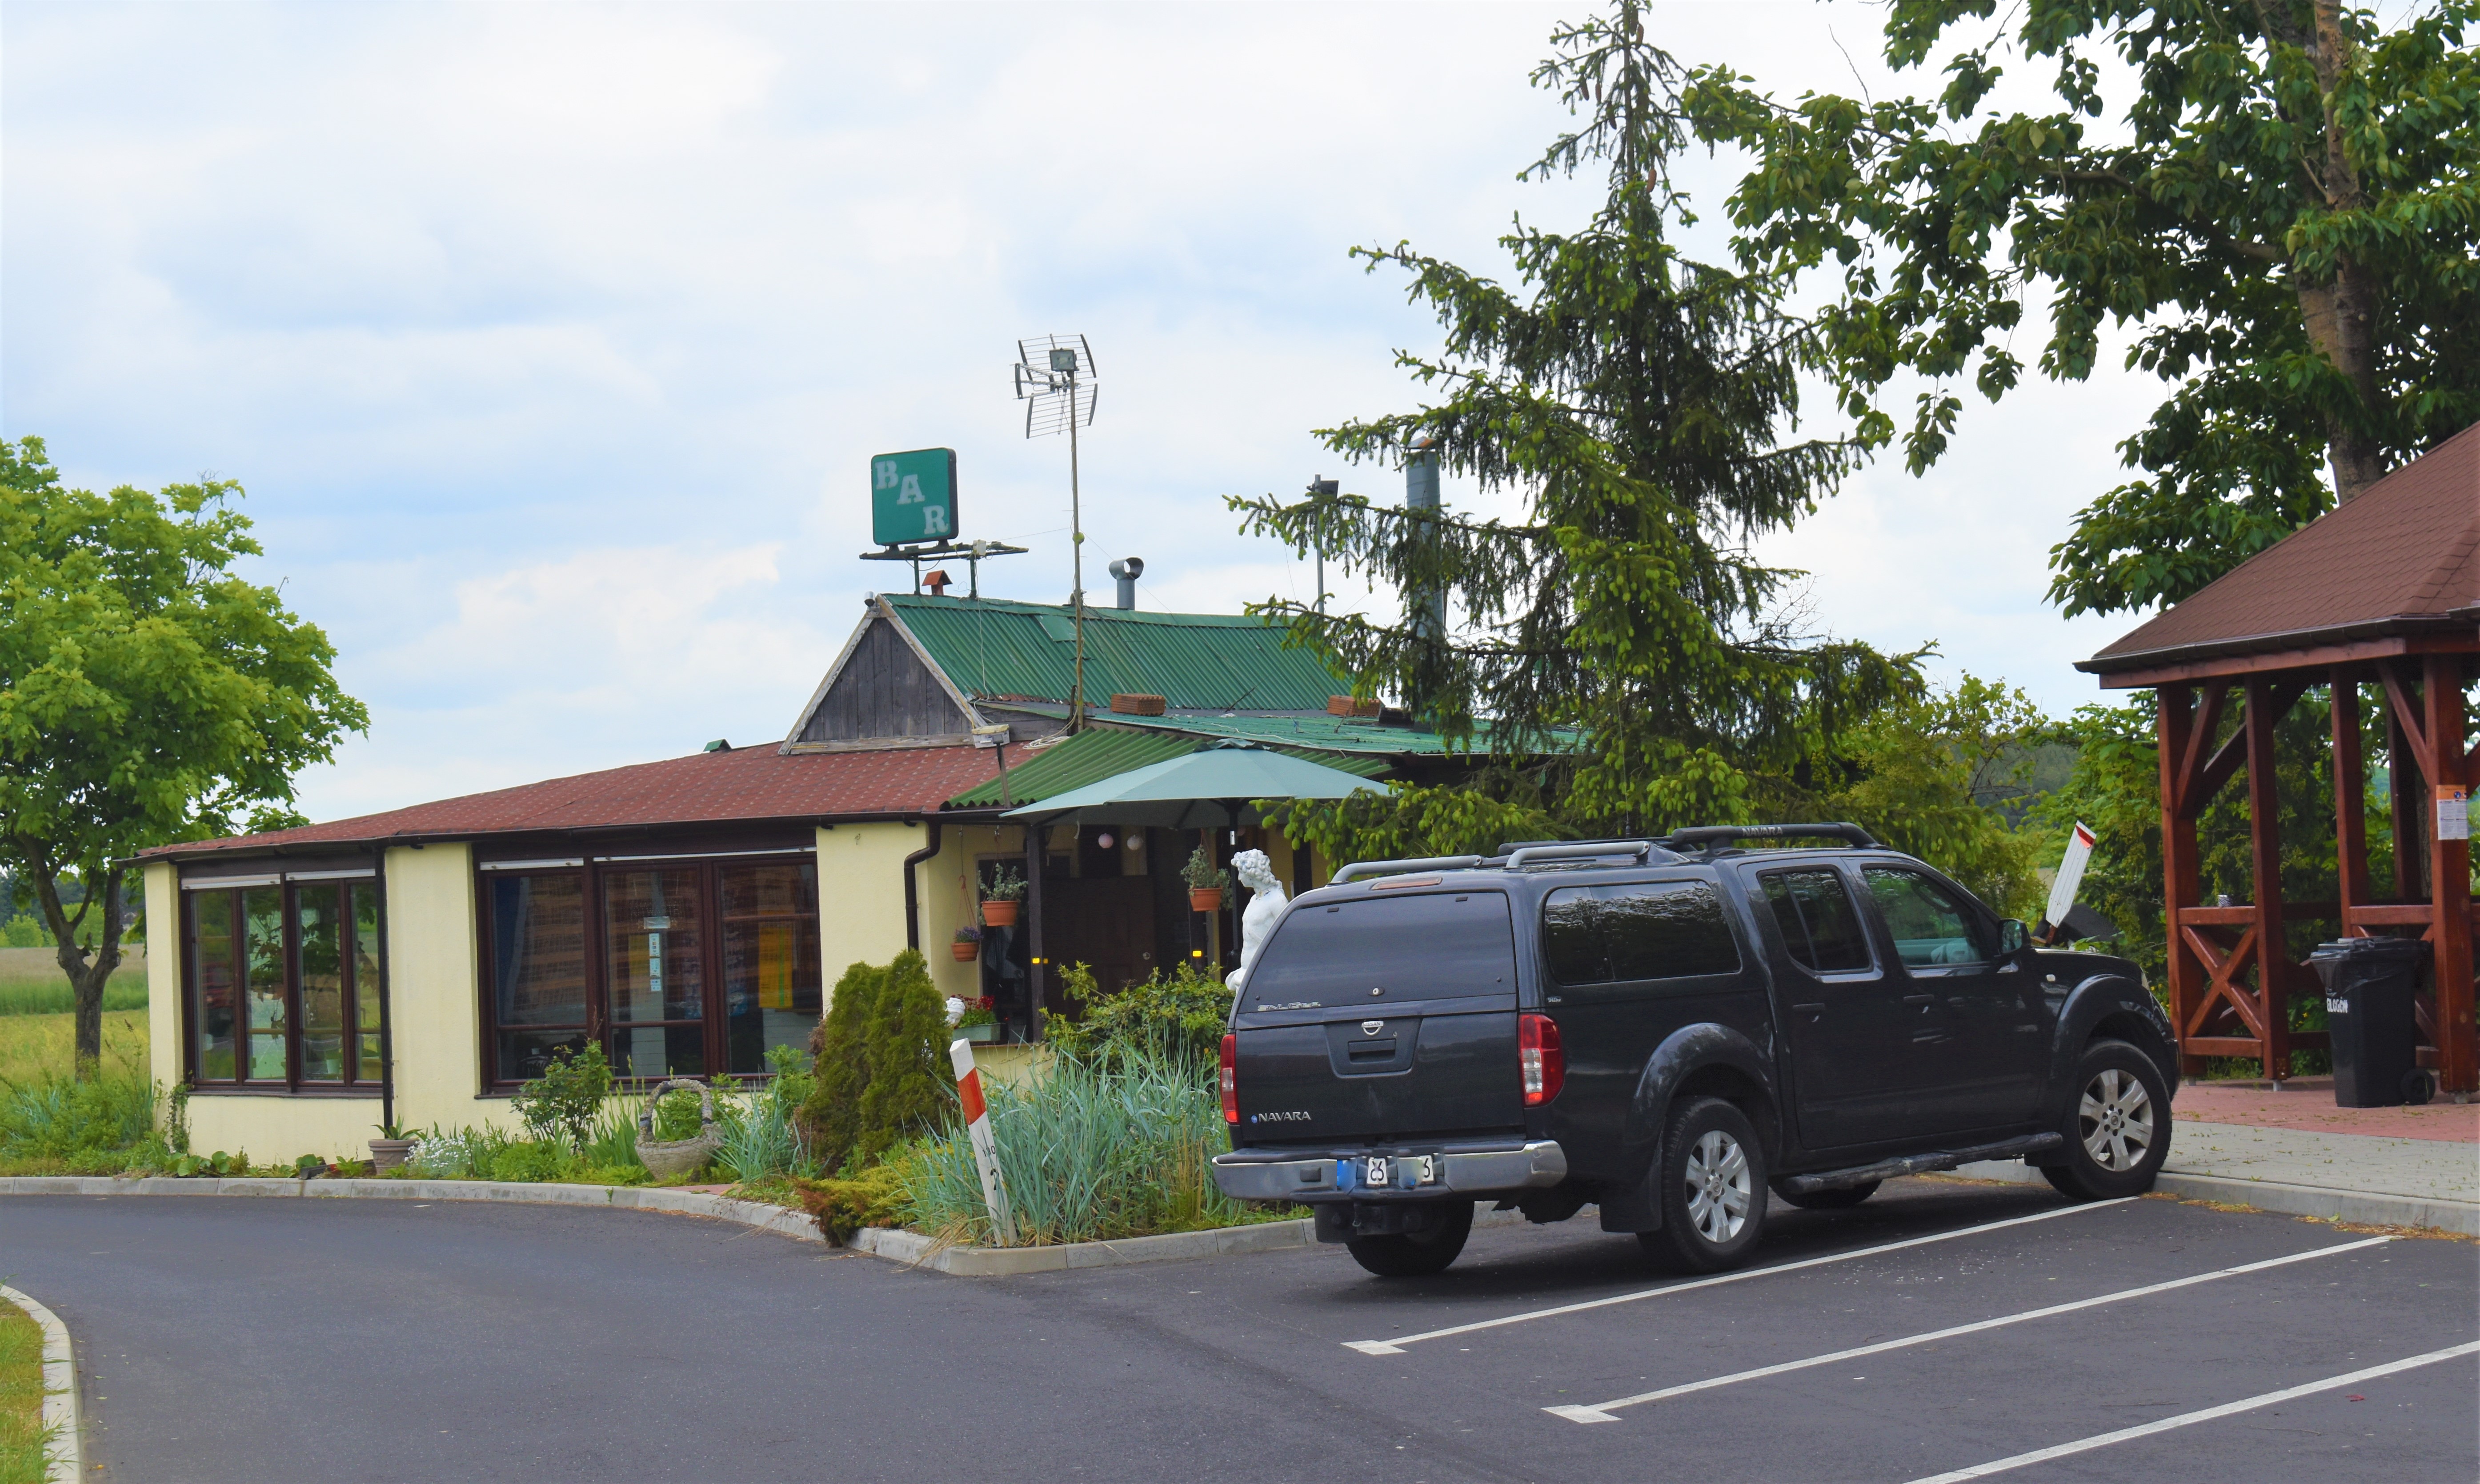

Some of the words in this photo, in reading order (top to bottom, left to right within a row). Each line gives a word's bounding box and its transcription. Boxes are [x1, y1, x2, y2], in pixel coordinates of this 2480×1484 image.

[875, 460, 949, 534] BAR
[1742, 826, 1783, 836] NAVARA
[1258, 1111, 1311, 1122] NAVARA
